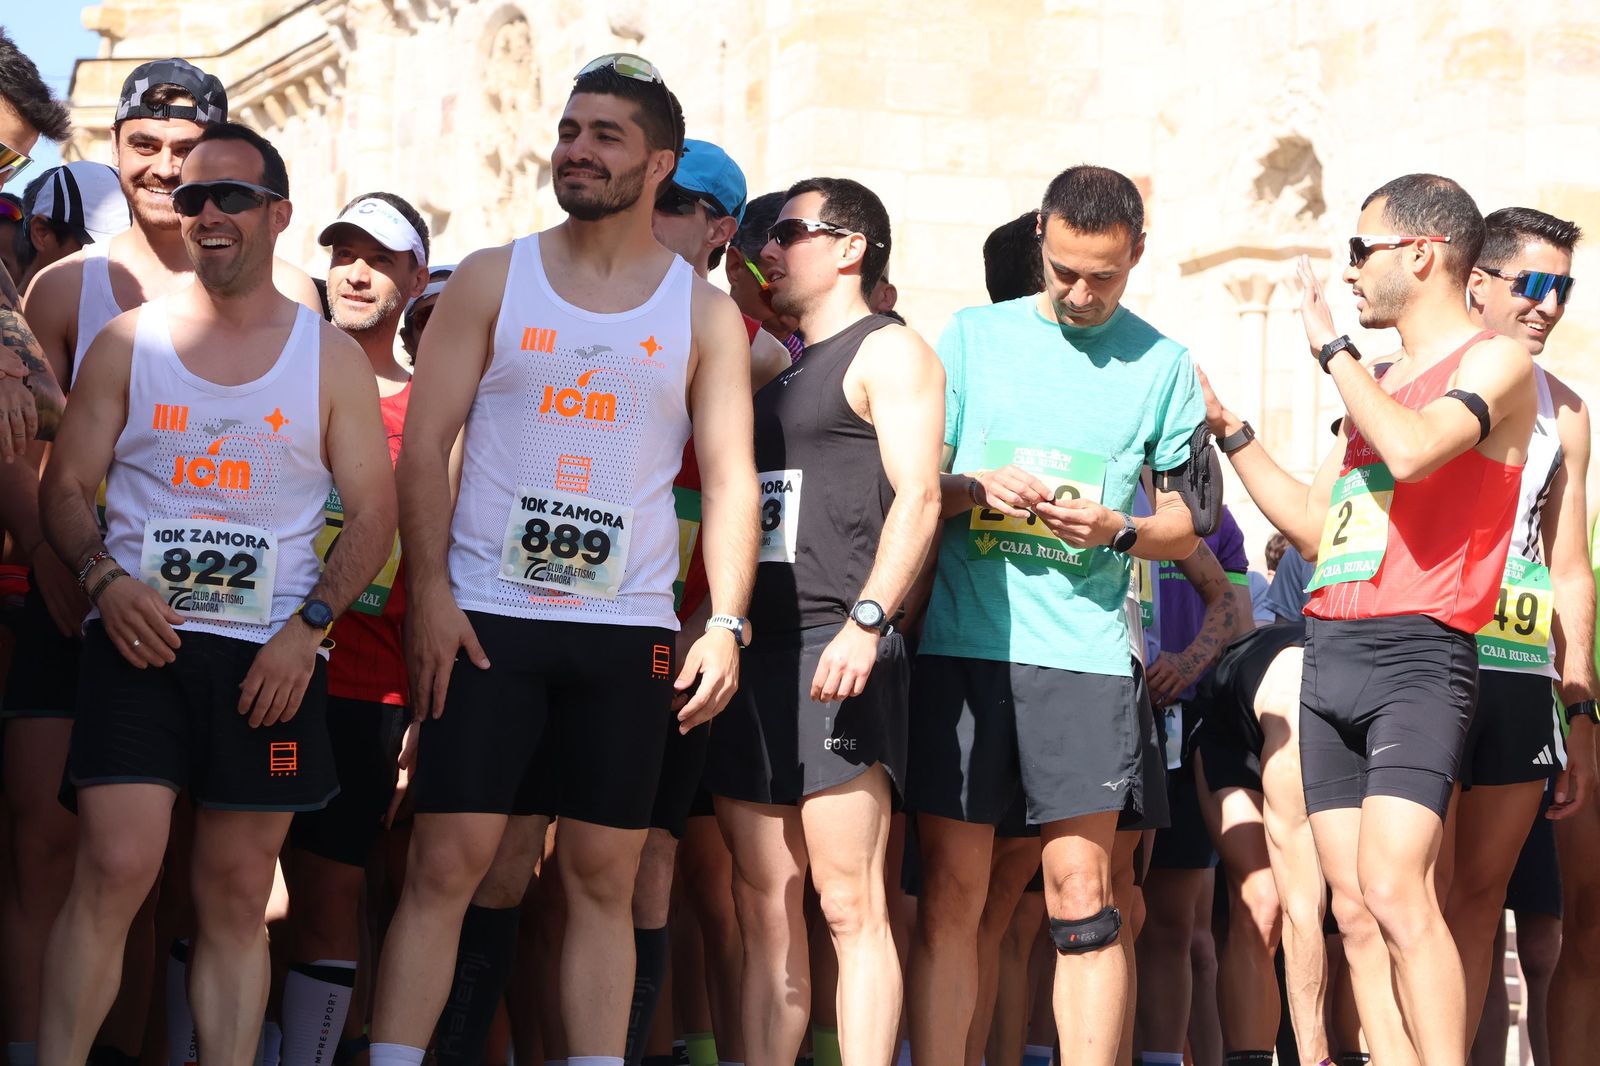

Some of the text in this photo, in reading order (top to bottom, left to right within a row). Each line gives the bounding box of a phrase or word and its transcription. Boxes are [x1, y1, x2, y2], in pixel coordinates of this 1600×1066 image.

[326, 504, 344, 512] ZAMO
[521, 496, 624, 530] 10K ZAMORA
[1332, 500, 1353, 546] 2
[153, 529, 270, 550] 10K ZAMORA
[521, 518, 611, 565] 889
[1000, 540, 1083, 566] CAJA RURAL
[160, 548, 258, 590] 822
[545, 571, 572, 586] ZAMORA
[547, 562, 596, 581] CLUB ATLETISMO
[191, 601, 219, 613] ZAMORA
[192, 590, 244, 606] CLUB ATLETISMO
[358, 592, 381, 607] RAL
[1481, 644, 1546, 663] CAJA RURAL
[824, 738, 857, 750] GORE
[315, 993, 338, 1066] MPRESSPORT
